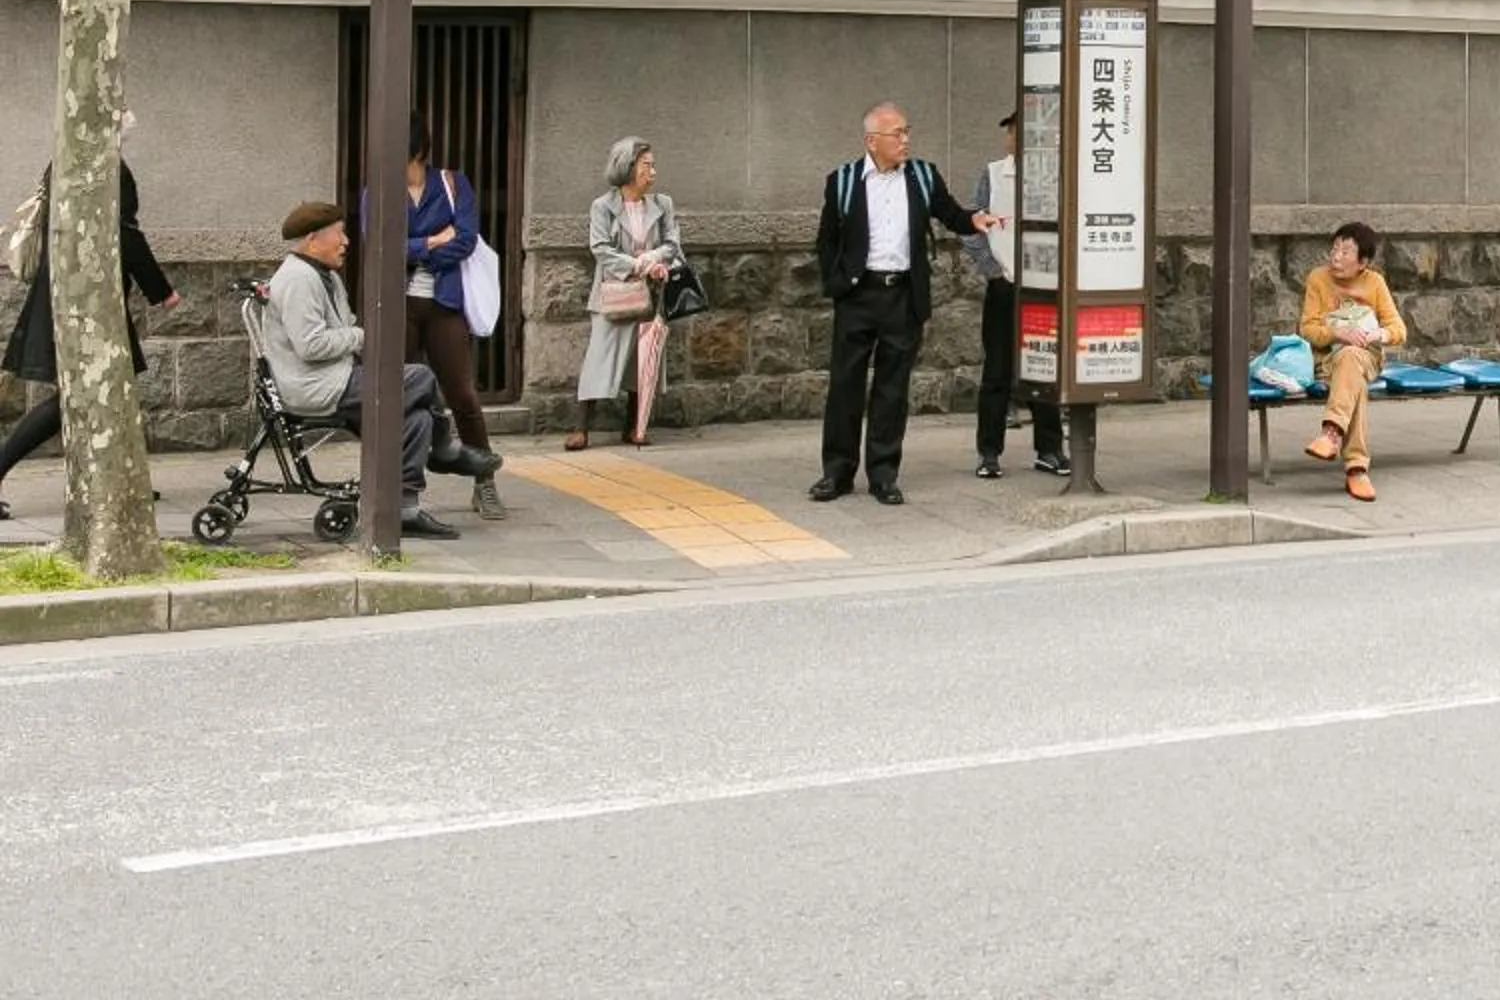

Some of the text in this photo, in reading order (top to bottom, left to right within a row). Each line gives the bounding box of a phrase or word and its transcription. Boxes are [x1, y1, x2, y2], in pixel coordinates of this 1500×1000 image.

[1122, 59, 1133, 91] Shijo
[1091, 58, 1115, 173] 四条大宮
